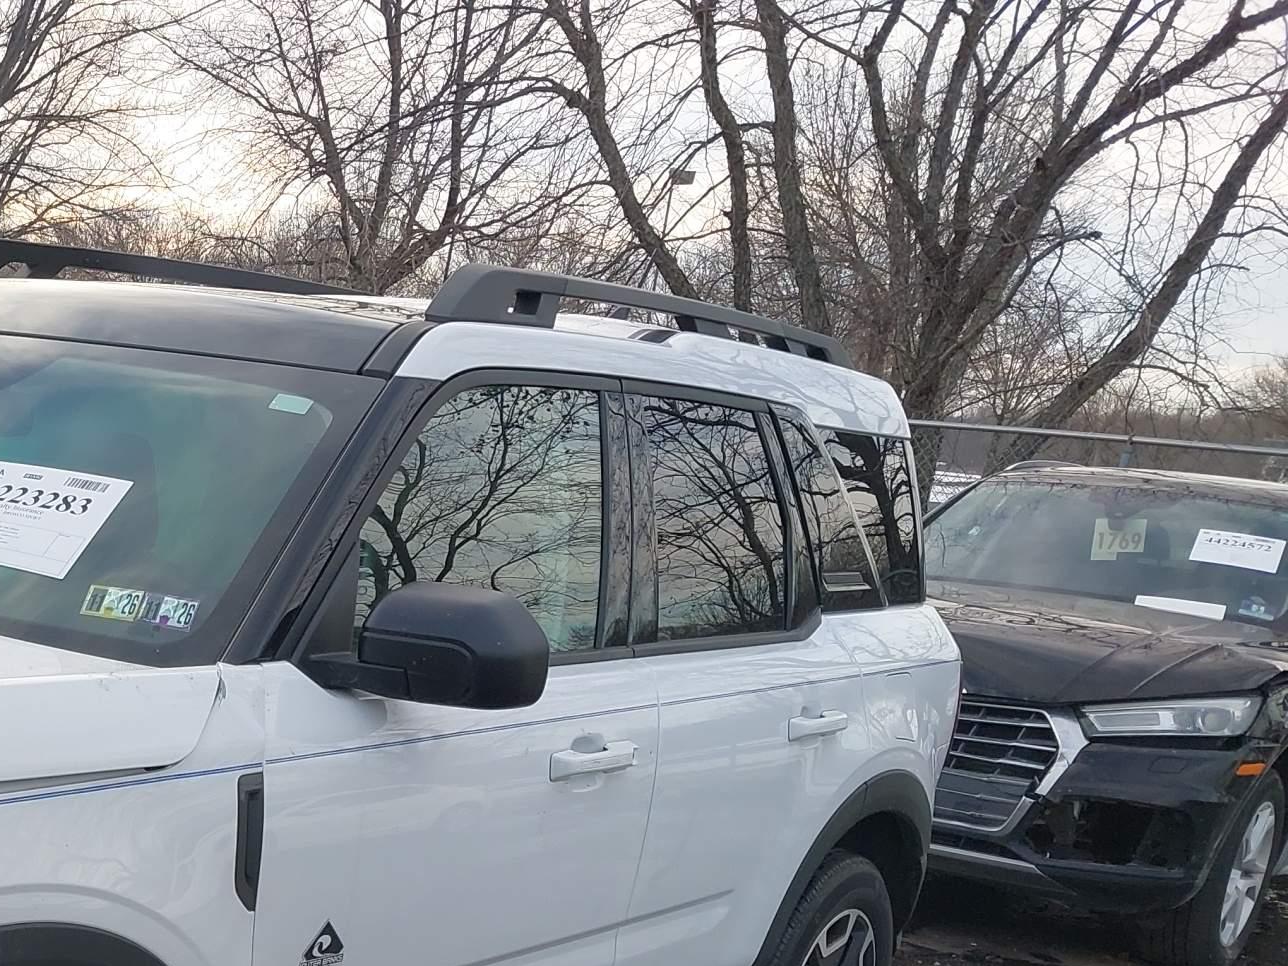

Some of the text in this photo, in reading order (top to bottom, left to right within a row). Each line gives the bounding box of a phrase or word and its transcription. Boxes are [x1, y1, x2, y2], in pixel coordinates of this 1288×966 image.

[1097, 531, 1142, 551] 1769
[1206, 537, 1272, 552] 44224572
[120, 593, 140, 616] 26
[176, 602, 196, 626] 26
